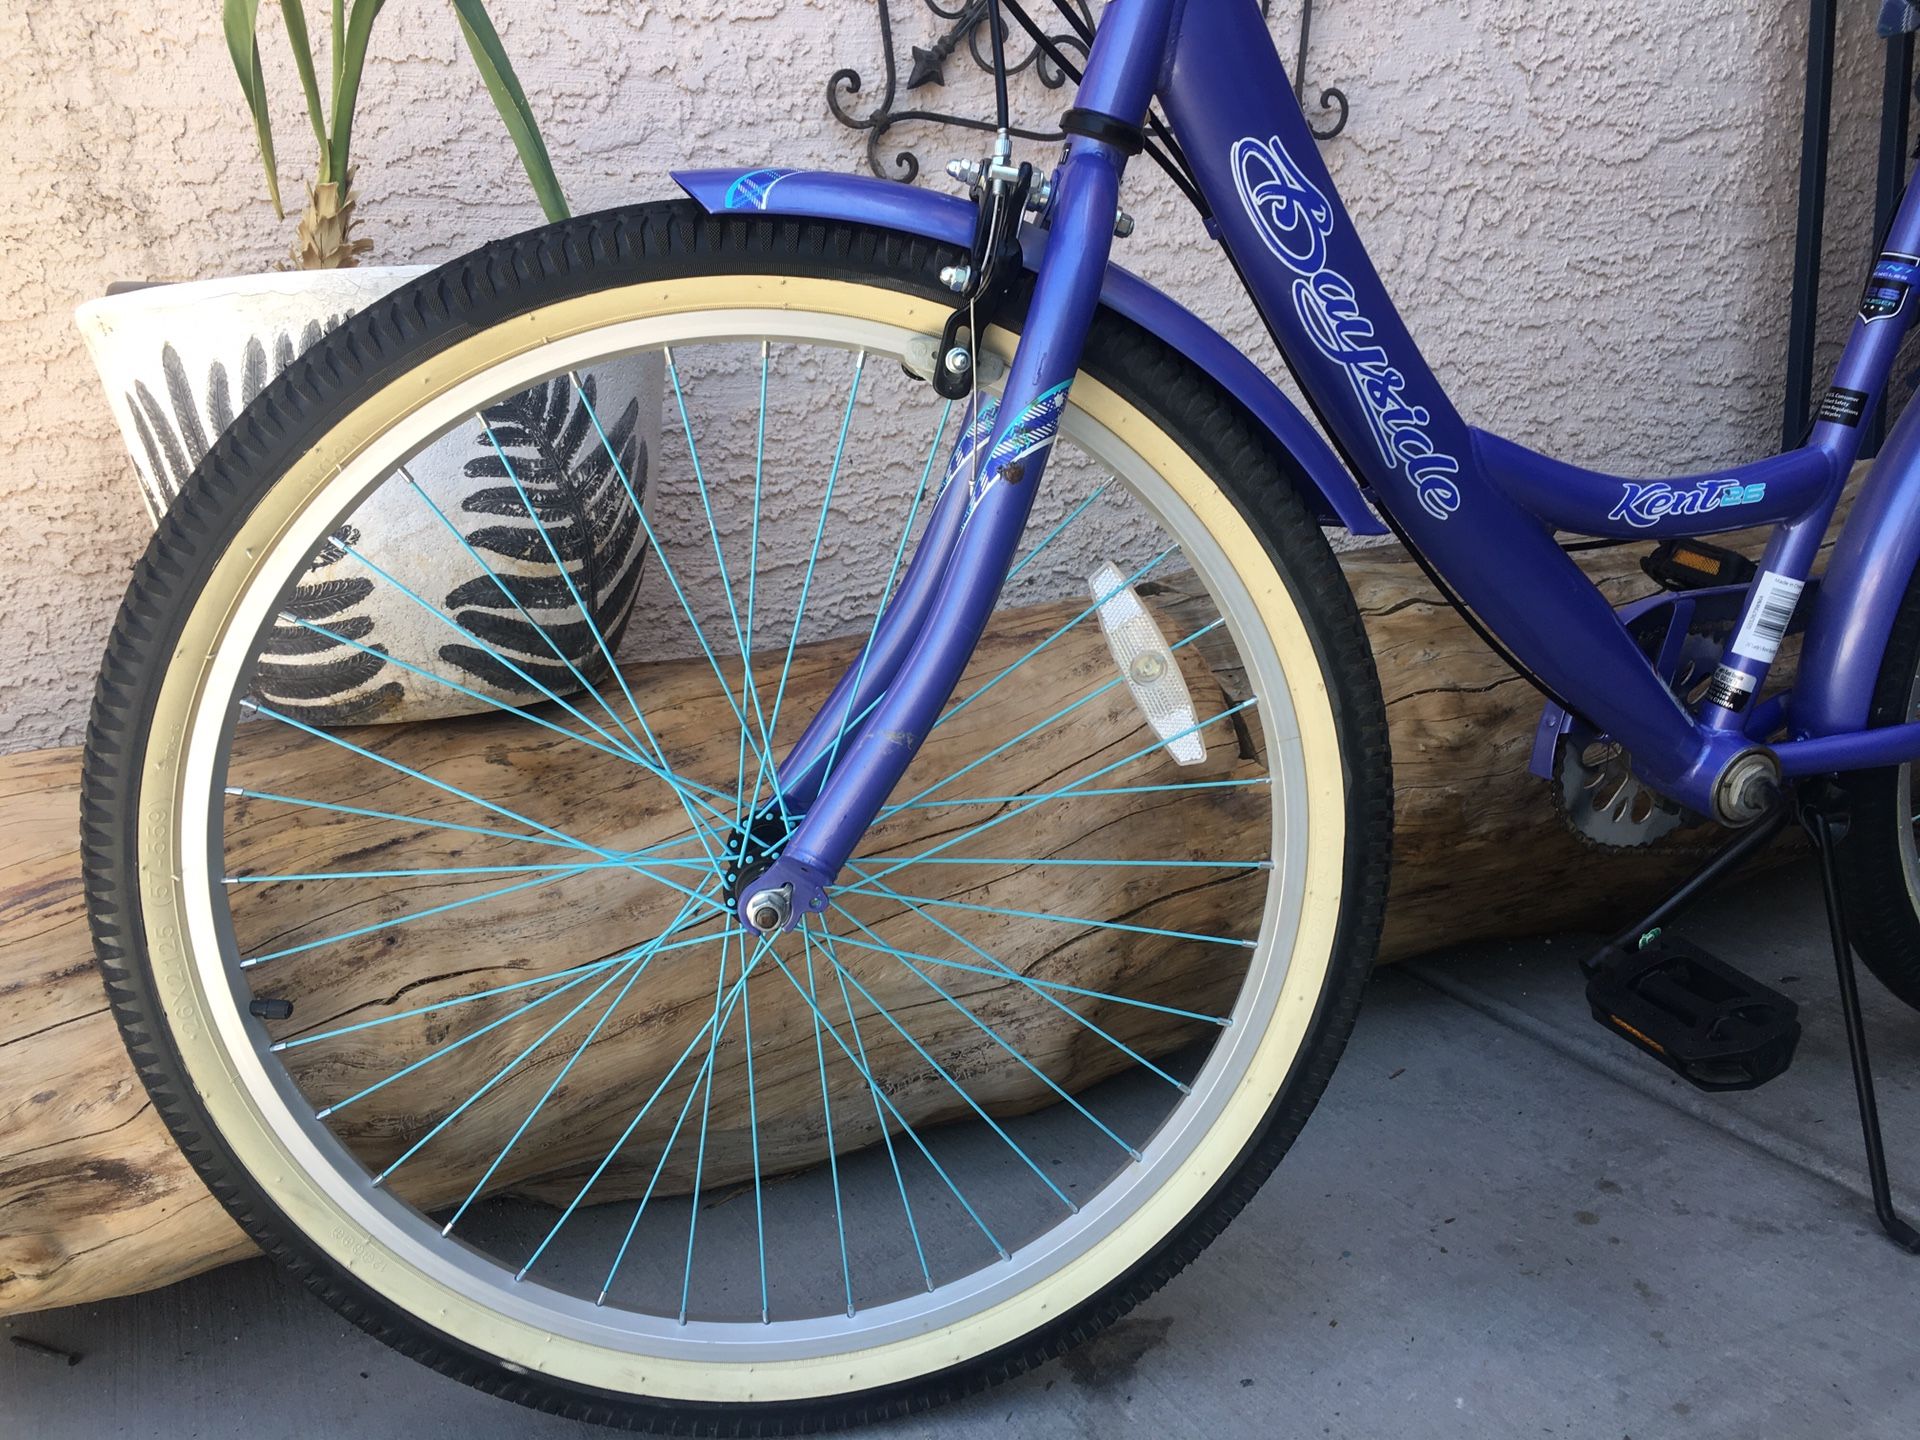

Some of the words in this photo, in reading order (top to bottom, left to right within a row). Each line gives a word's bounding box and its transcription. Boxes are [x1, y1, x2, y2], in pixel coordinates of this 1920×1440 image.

[1229, 135, 1461, 521] Bayside
[1608, 479, 1739, 528] Kent
[1719, 483, 1766, 507] 26
